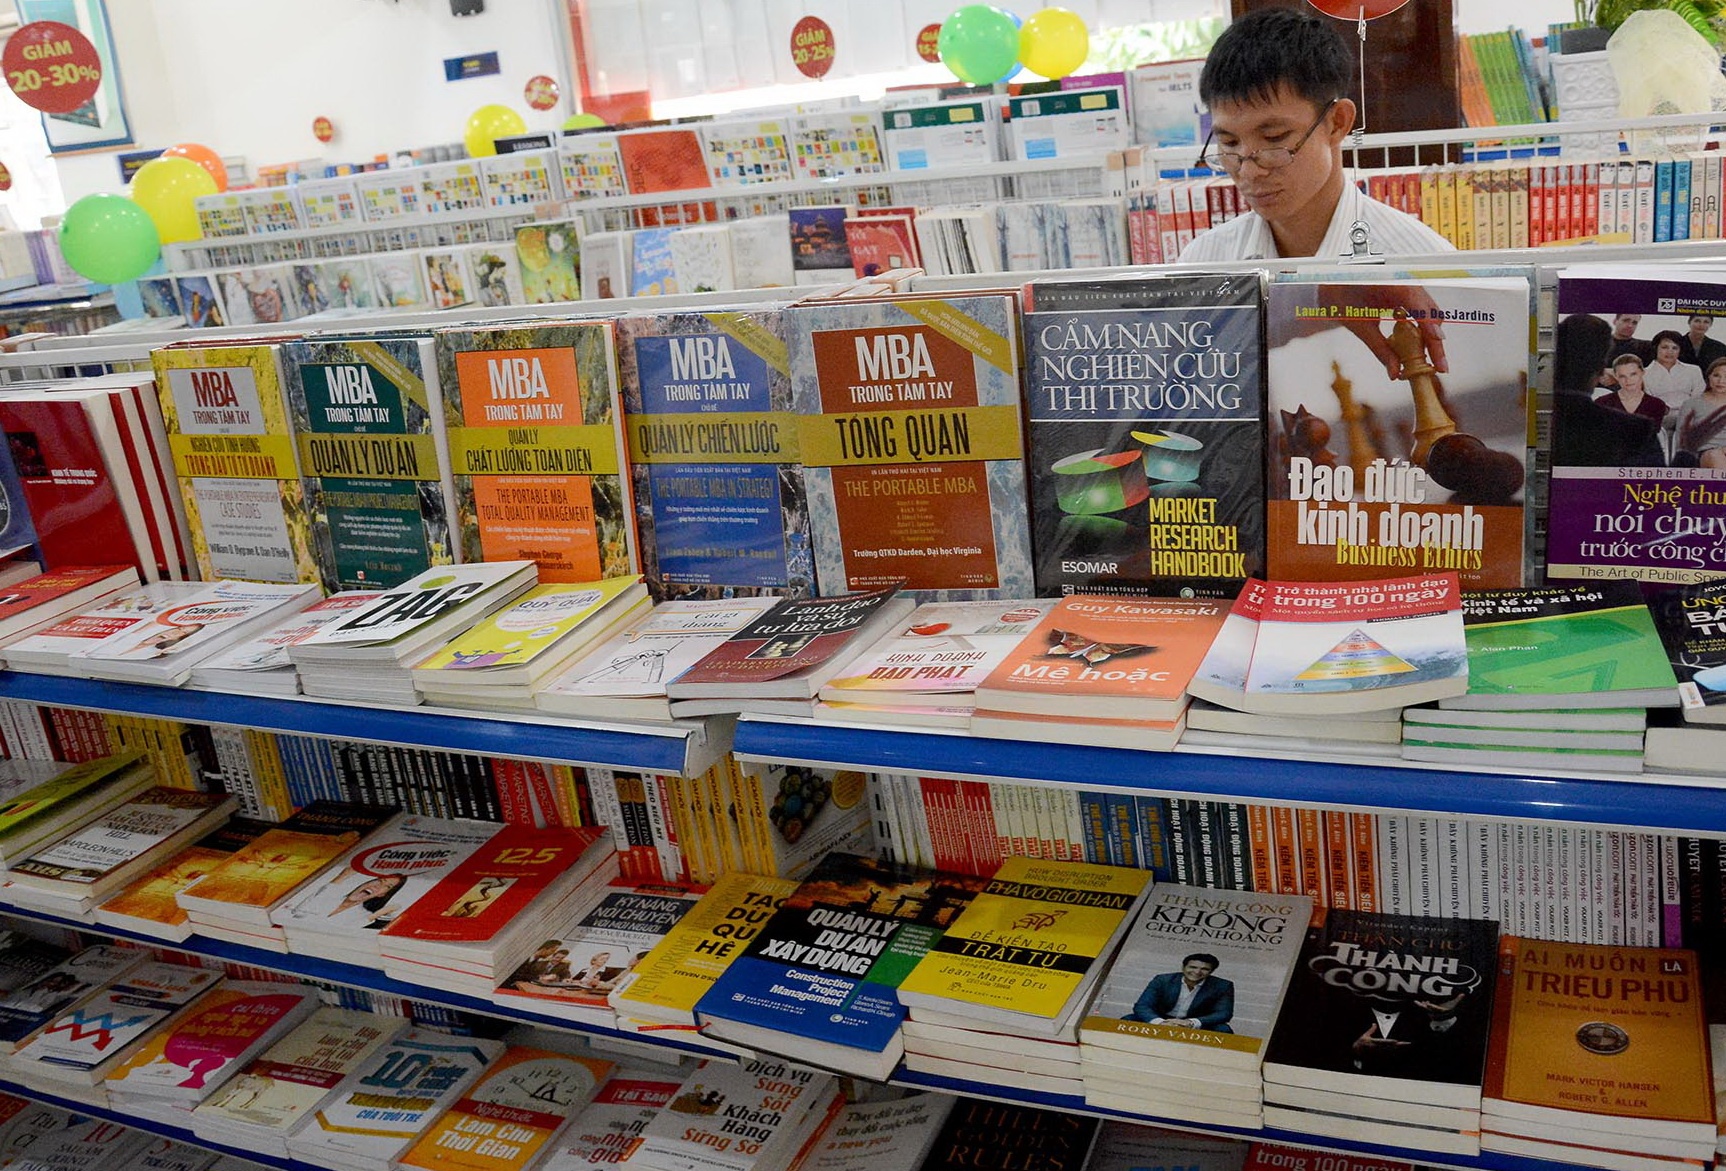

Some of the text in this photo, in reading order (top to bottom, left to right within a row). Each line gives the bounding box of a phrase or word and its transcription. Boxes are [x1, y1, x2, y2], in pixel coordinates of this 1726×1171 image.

[22, 37, 74, 62] GIẢM
[9, 62, 100, 93] 20-30%
[1040, 317, 1111, 351] CẨM
[1115, 321, 1213, 350] NANG
[668, 336, 737, 382] MBA
[853, 332, 936, 381] MBA
[1041, 347, 1242, 381] NGHIÊN CỨU
[190, 370, 240, 408] MBA
[324, 365, 379, 405] MBA
[487, 357, 551, 400] MBA
[663, 384, 702, 403] TRONG
[729, 383, 751, 400] TAY
[848, 384, 894, 404] TRONG
[927, 381, 954, 399] TAY
[1042, 379, 1243, 414] THỊ TRƯỜNG
[324, 407, 355, 424] TRONG
[374, 407, 390, 424] TAY
[483, 404, 518, 422] TRONG
[543, 403, 565, 420] TAY
[834, 412, 972, 461] TỔNG QUAN
[309, 434, 352, 477] QUẢN
[352, 436, 370, 477] LÝ
[396, 436, 419, 477] ÁN
[843, 477, 978, 498] THE PORTABLE MBA
[1287, 457, 1428, 504] Đạo đức
[497, 487, 569, 505] THE PORTABLE MBA
[1623, 482, 1683, 509] Nghệ
[482, 505, 591, 523] TOTAL QUALITY MANAGEMENT
[1149, 497, 1218, 523] MARKET
[1593, 502, 1645, 533] nói
[1150, 523, 1238, 551] RESEARCH
[1297, 501, 1485, 551] kinh doanh
[953, 546, 983, 558] Virginia
[1151, 550, 1247, 578] HANDBOOK
[1336, 538, 1483, 571] Business Ethics
[1061, 561, 1119, 575] ESOMAR
[1579, 566, 1603, 578] The
[1607, 567, 1628, 579] Art
[1631, 567, 1645, 579] of
[1648, 568, 1690, 581] Public
[1272, 586, 1451, 611] trong 100 ngày
[1275, 577, 1450, 596] Trở thành nhà lãnh đạo
[1065, 602, 1109, 617] Guy
[1113, 603, 1219, 616] Kawasaki
[1460, 599, 1497, 608] Kinh
[1523, 597, 1547, 607] và
[1574, 592, 1604, 603] hội
[1497, 605, 1540, 615] Nam
[885, 651, 989, 664] KINH DOANH
[1010, 663, 1171, 684] Mê hoặc
[622, 804, 638, 845] SOLUTION
[1174, 854, 1187, 881] DOANH
[1161, 893, 1294, 916] THÀNH CÔNG
[806, 906, 900, 938] QUẢN LÝ
[1148, 903, 1287, 935] KHÔNG
[812, 927, 887, 957] DỰ ÁN
[970, 928, 993, 941] ĐỂ
[1145, 919, 1285, 946] CHỚP NHOÁNG
[693, 938, 737, 960] HỆ
[758, 937, 872, 977] XÂY DỰNG
[959, 940, 1018, 963] TRẬT
[1026, 951, 1062, 970] TỰ
[1329, 940, 1460, 975] THÀNH
[1522, 949, 1683, 974] AI MUỐN LÀ
[784, 968, 856, 991] Construction
[807, 982, 850, 999] Project
[938, 964, 1018, 986] Jean-Marie
[1020, 977, 1049, 991] Dru
[1322, 965, 1455, 997] CÔNG
[767, 983, 843, 1008] Management
[1115, 1022, 1225, 1045] RORY VADEN
[745, 1058, 816, 1089] Dịch vụ
[1546, 1072, 1660, 1093] MARK VICTOR HANSEN
[1558, 1090, 1598, 1104] ROBERT
[1614, 1096, 1649, 1109] ALLEN
[722, 1103, 783, 1128] Khách
[720, 1117, 774, 1142] Hàng
[434, 1131, 522, 1161] Thời Gian
